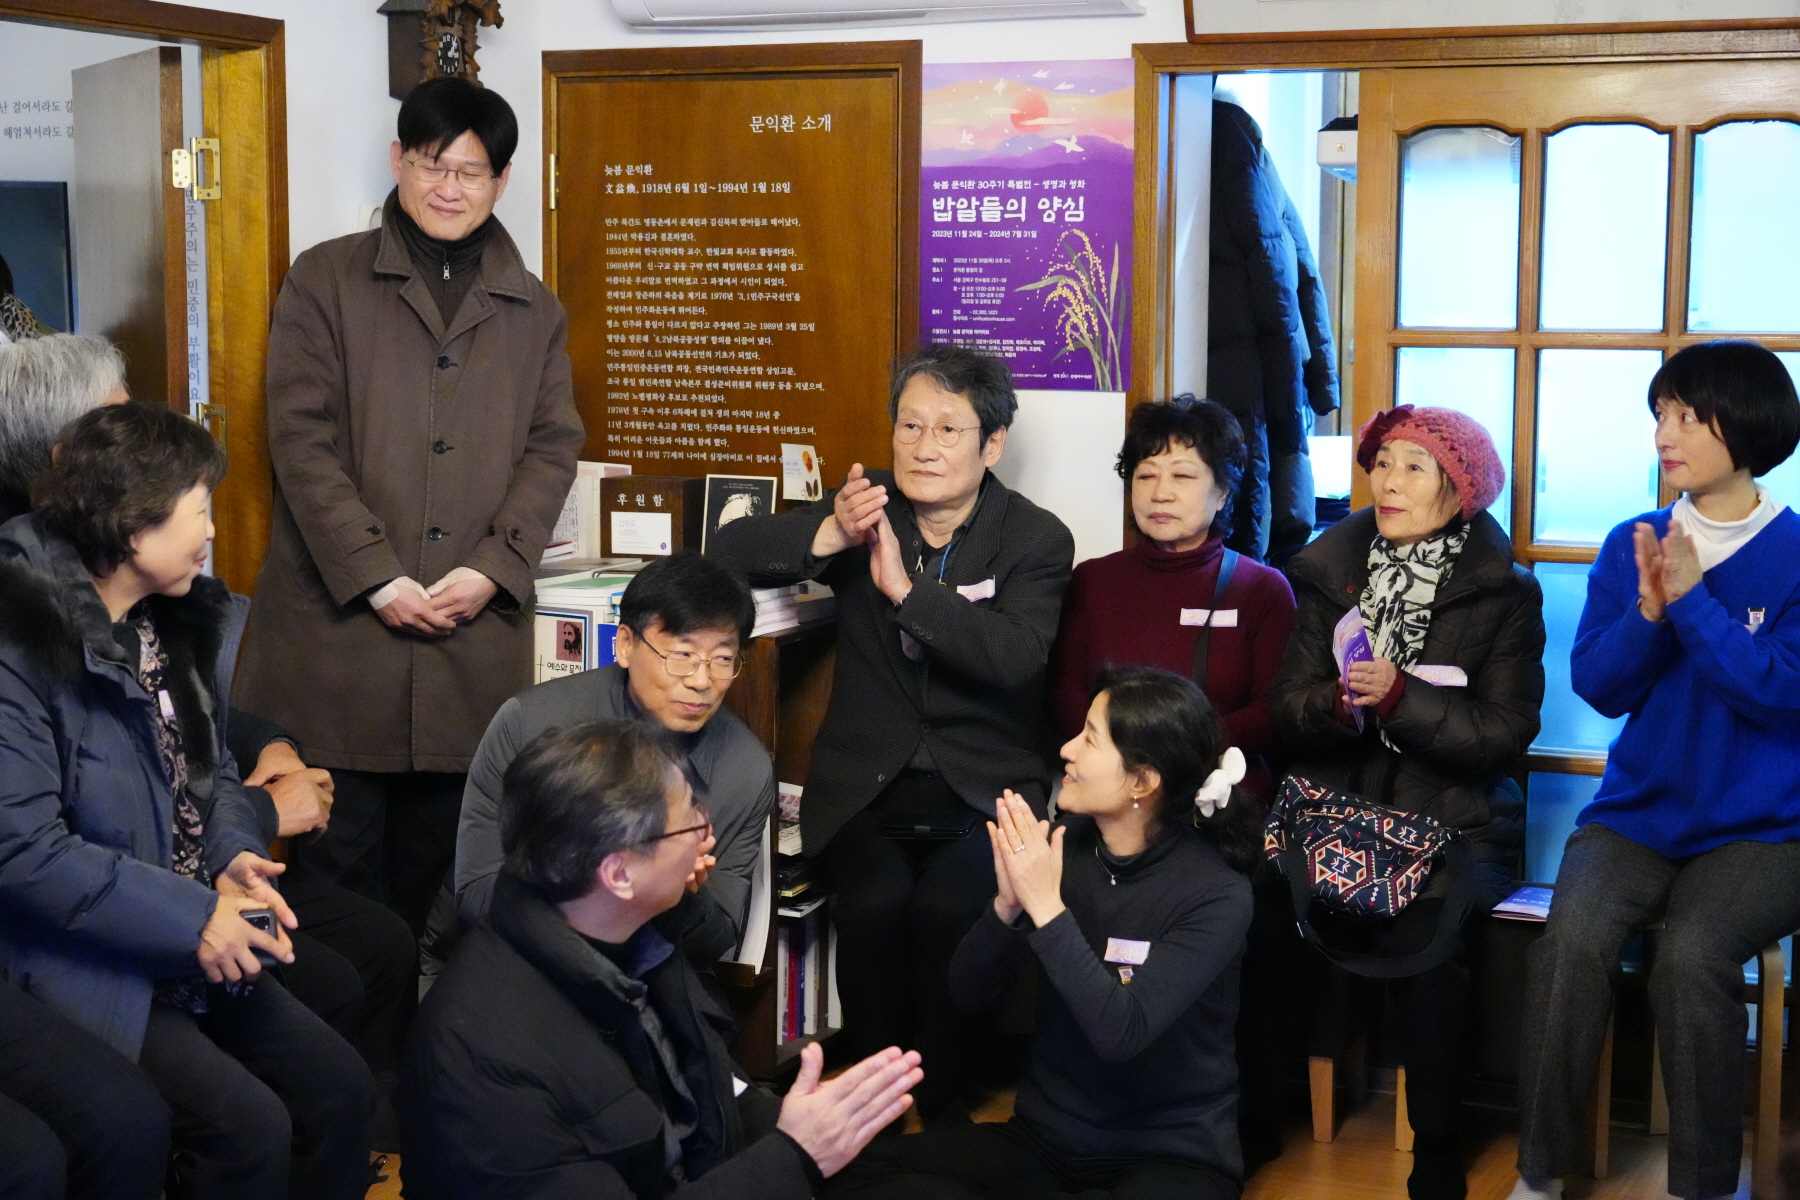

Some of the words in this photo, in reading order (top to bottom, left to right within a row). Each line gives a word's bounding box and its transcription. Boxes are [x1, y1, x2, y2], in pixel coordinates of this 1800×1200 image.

[12, 100, 61, 114] 걸어서라도
[750, 115, 796, 132] 문익환
[802, 114, 831, 132] 소개
[3, 125, 61, 139] 헤엄쳐서라도
[605, 165, 622, 176] 늦봄
[626, 164, 653, 175] 문익환
[642, 183, 672, 193] 1918년
[675, 183, 690, 194] 6월
[753, 182, 766, 193] 1월
[771, 182, 790, 193] 18일
[933, 180, 949, 190] 늦봄
[951, 180, 975, 190] 문익환
[977, 180, 1004, 190] 30주기
[1007, 179, 1031, 189] 특별전
[1042, 179, 1067, 189] 생명과
[1069, 179, 1086, 189] 평화
[932, 196, 1026, 223] 밥알들의
[1038, 196, 1085, 223] 양심
[931, 230, 952, 238] 2023년
[954, 230, 967, 238] 11월
[969, 230, 982, 238] 24일
[989, 230, 1011, 238] 2024년
[1012, 230, 1023, 238] 7월
[1023, 230, 1037, 238] 31일
[187, 279, 199, 329] 민중의
